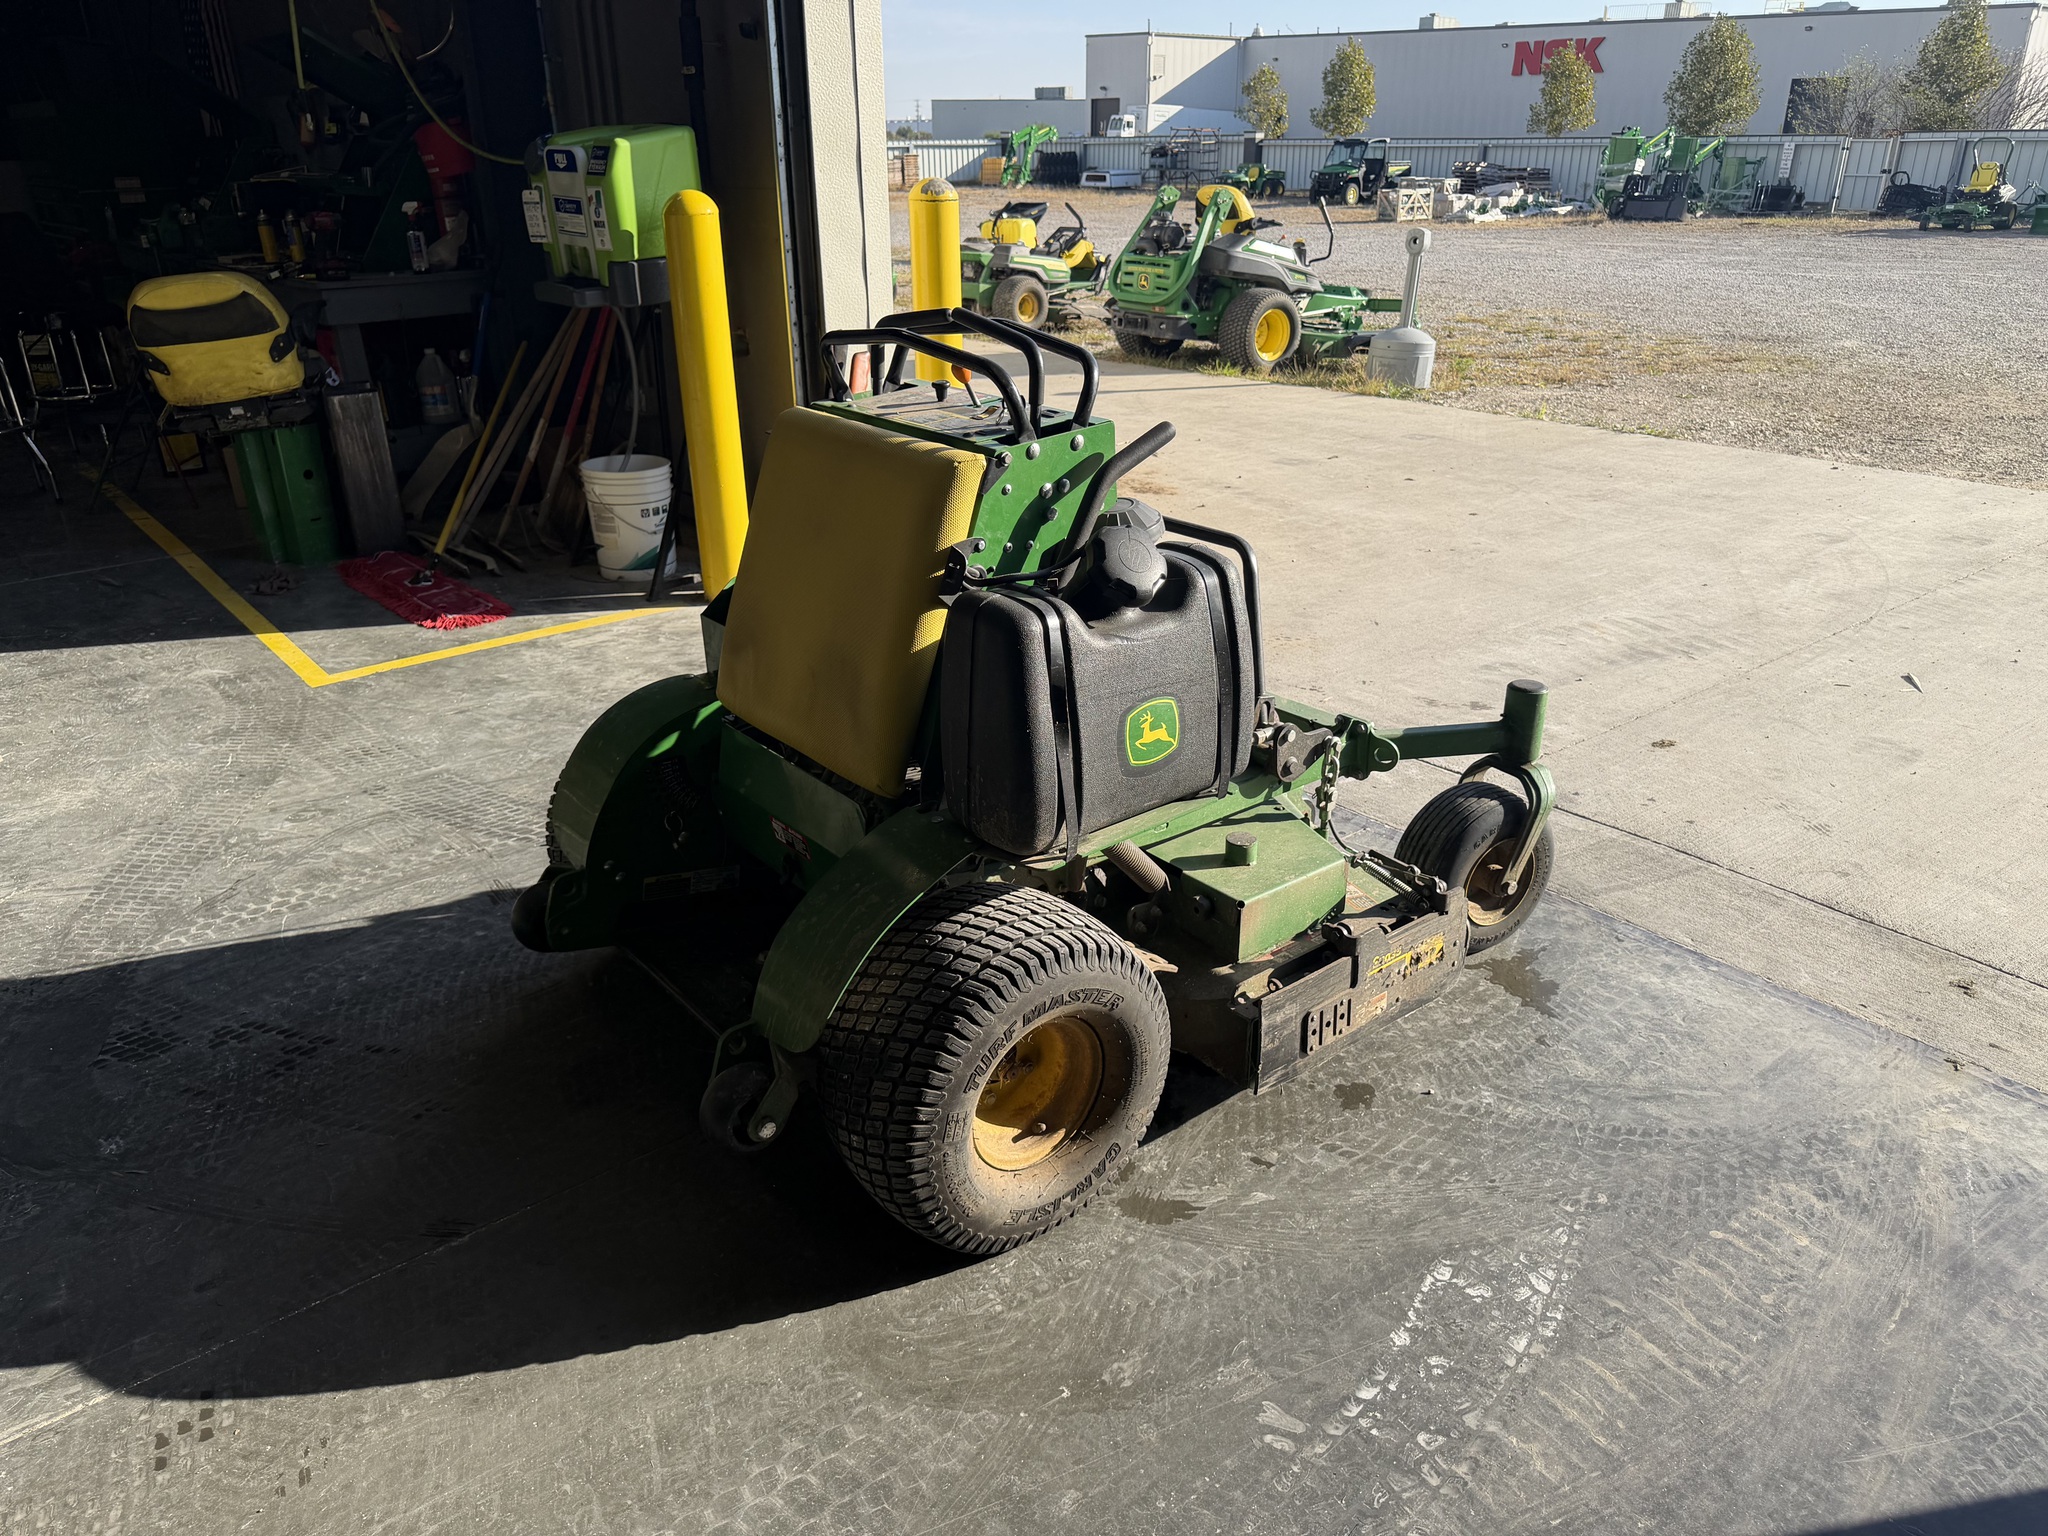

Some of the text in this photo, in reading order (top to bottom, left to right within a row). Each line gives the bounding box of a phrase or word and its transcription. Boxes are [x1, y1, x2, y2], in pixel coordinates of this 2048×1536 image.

[1511, 37, 1606, 76] NSK
[554, 153, 567, 164] PULL
[963, 988, 1125, 1094] TURF MASTER
[1003, 1142, 1121, 1226] CARLISLE
